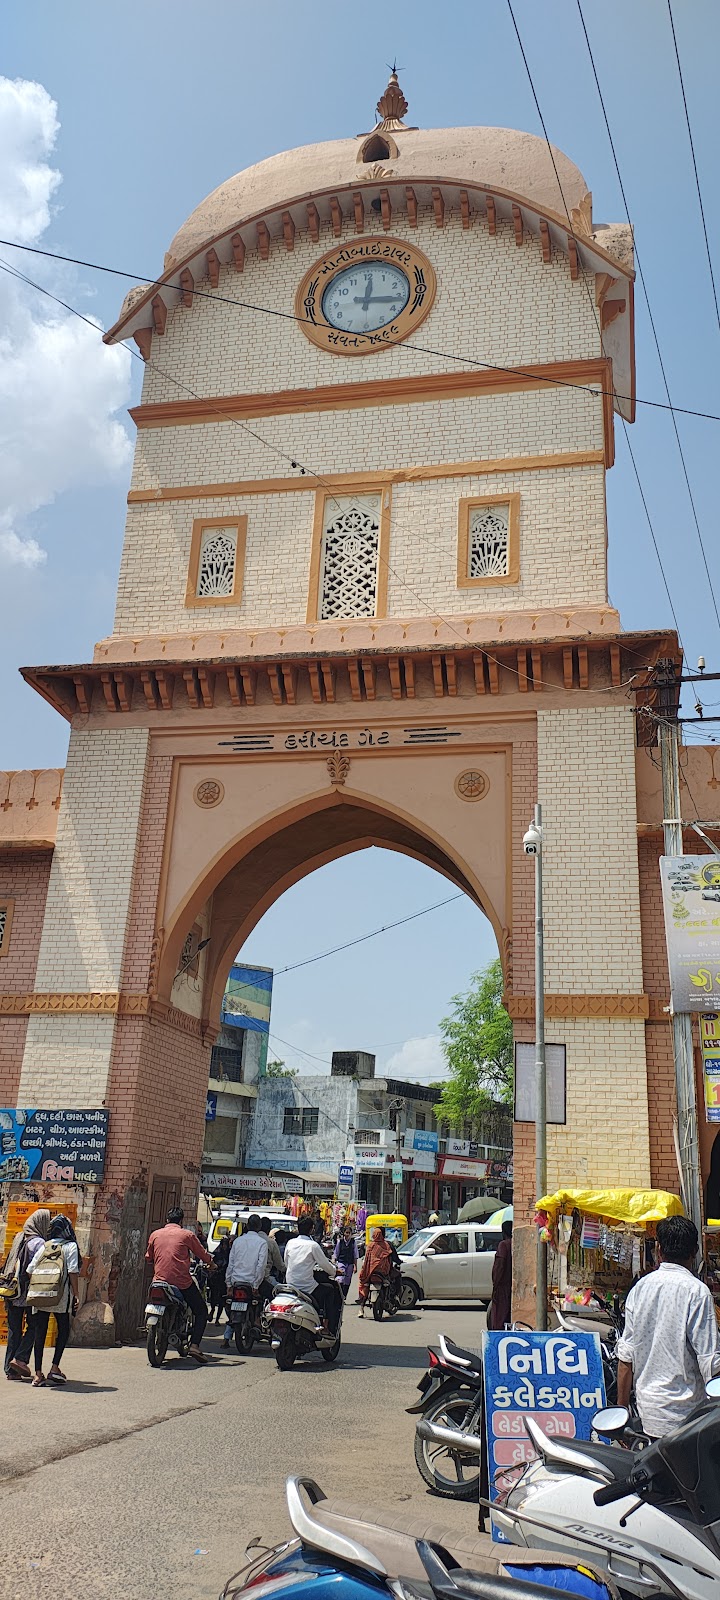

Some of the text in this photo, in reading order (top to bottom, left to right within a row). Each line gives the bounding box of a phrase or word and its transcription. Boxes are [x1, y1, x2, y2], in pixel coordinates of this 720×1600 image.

[338, 288, 348, 296] 10
[284, 728, 390, 750] હરીચંદ ગેટ
[60, 1151, 78, 1161] અહીં
[41, 1160, 97, 1181] શિવ પાર્લર
[340, 1168, 353, 1176] ATM
[498, 1336, 588, 1375] નિધિ
[498, 1415, 569, 1434] લેડી ટોપ
[564, 1524, 635, 1549] Activa
